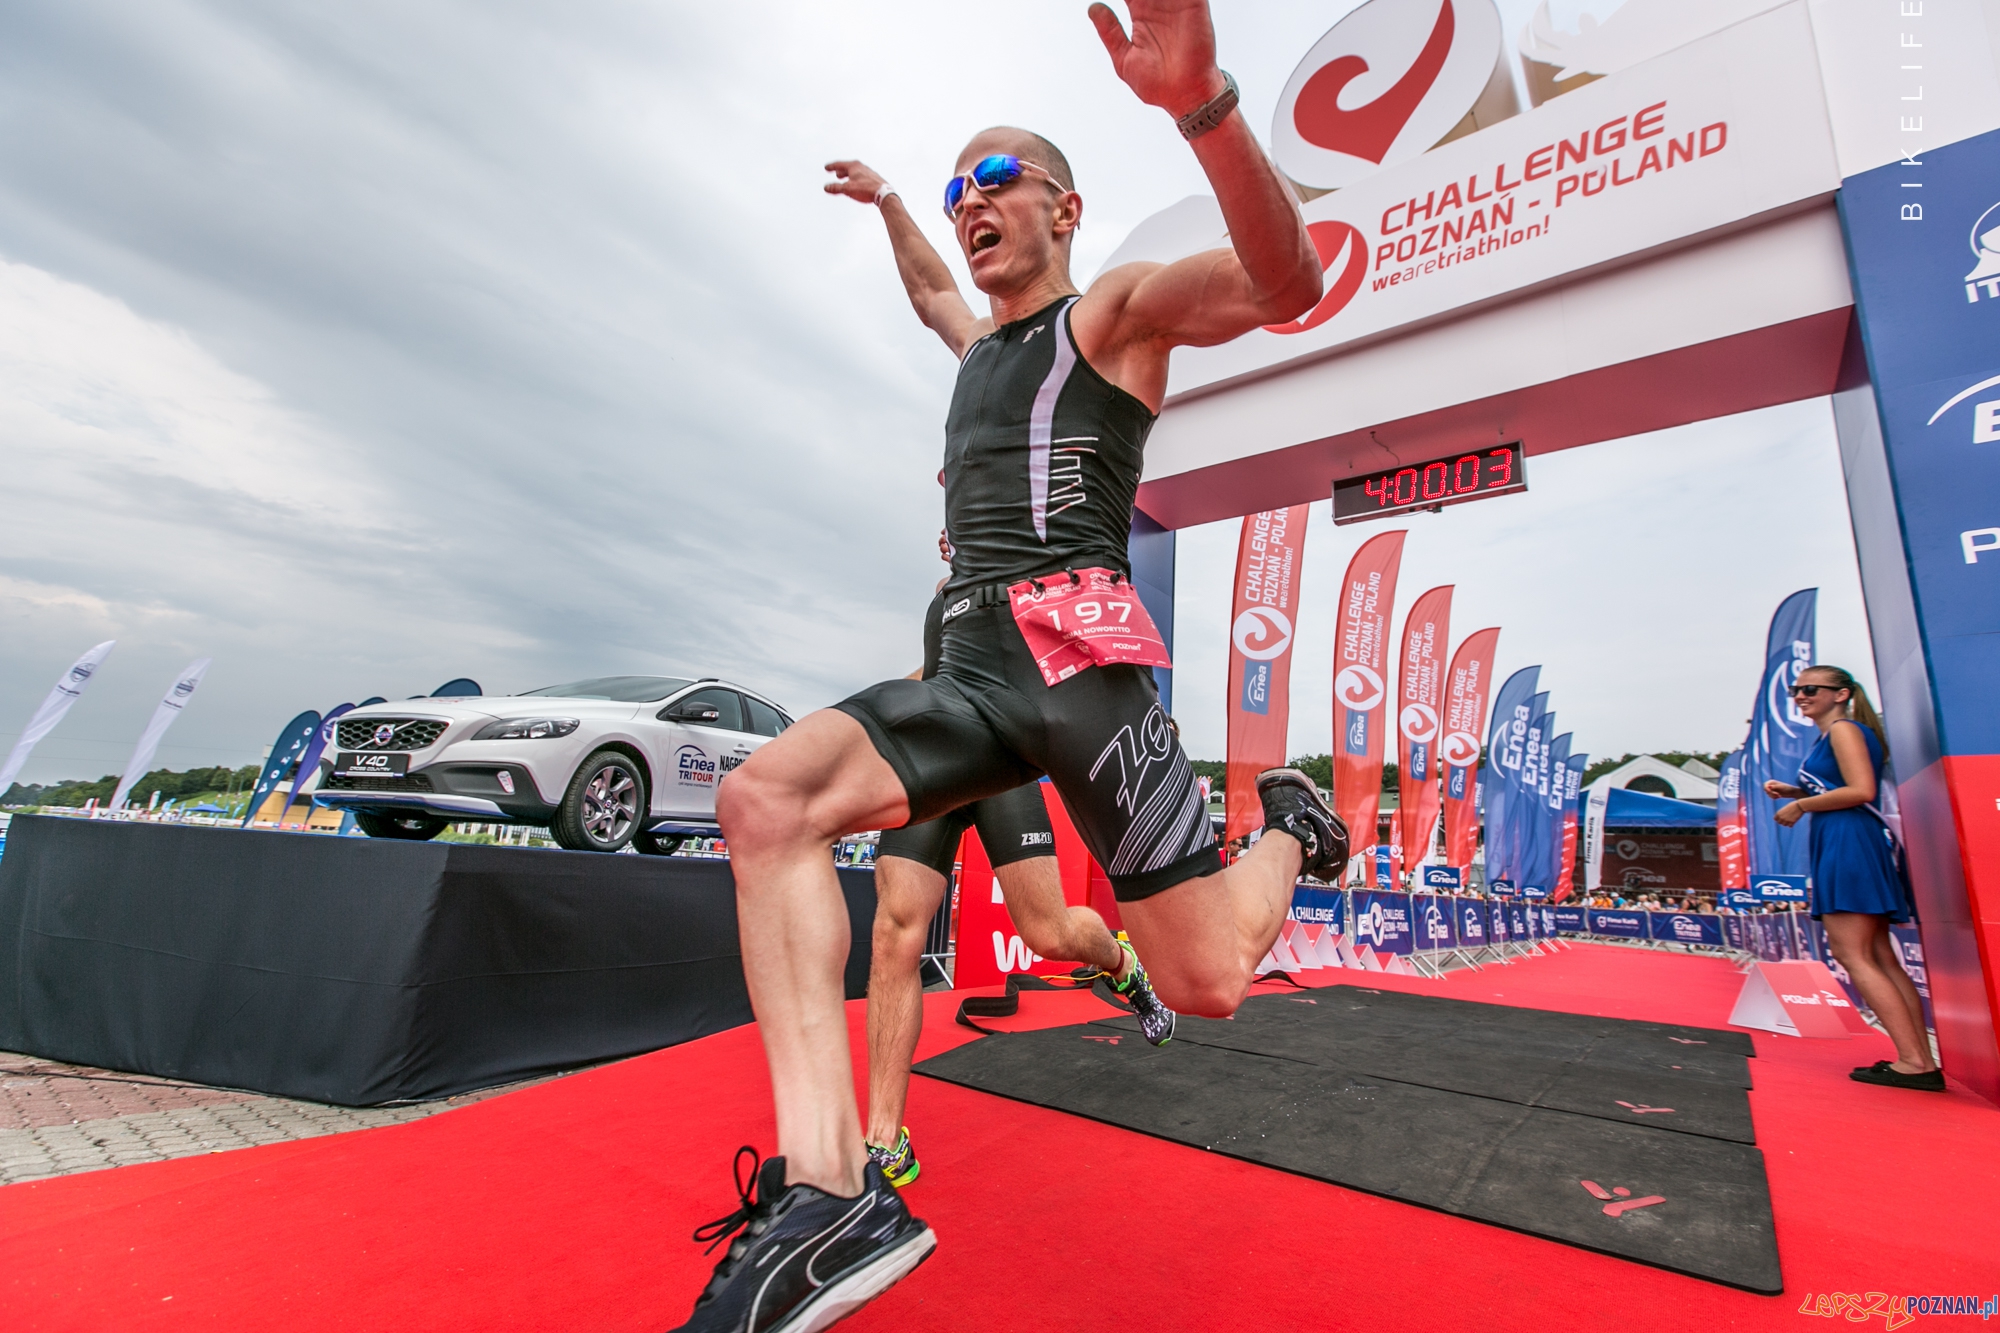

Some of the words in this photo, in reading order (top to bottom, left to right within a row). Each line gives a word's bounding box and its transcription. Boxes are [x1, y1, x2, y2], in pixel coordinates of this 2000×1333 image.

[1380, 100, 1668, 236] CHALLENGE
[1373, 191, 1515, 272] POZNAŃ
[1527, 199, 1542, 209] -
[1555, 121, 1728, 208] POLAND
[1371, 213, 1551, 293] wearetriathlon!
[1364, 448, 1512, 506] 4:00.03
[1270, 506, 1289, 546] POLAN
[1244, 511, 1272, 603] CHALLENGE
[1262, 555, 1282, 607] POZNAŃ
[1364, 571, 1381, 614] POLAND
[1047, 601, 1132, 632] 197
[1343, 581, 1366, 661] CHALLENGE
[1359, 621, 1374, 666] POZNAŃ
[1421, 622, 1435, 659] POLAND
[1253, 665, 1267, 702] Enea
[1405, 630, 1423, 701] CHALLENGE
[1466, 659, 1481, 695] POLAND
[1786, 640, 1814, 727] Eea
[1448, 667, 1467, 730] CHALLENGE
[1354, 714, 1365, 746] Enea
[1501, 704, 1530, 771] Enea
[678, 752, 715, 773] Enea
[678, 769, 714, 783] TRITOUR
[1415, 746, 1425, 773] Enea
[1521, 727, 1541, 786] Enea
[1549, 761, 1566, 811] Enea
[1429, 874, 1458, 885] Enea
[1761, 884, 1805, 897] Enea
[1295, 906, 1335, 922] CHALLENGE
